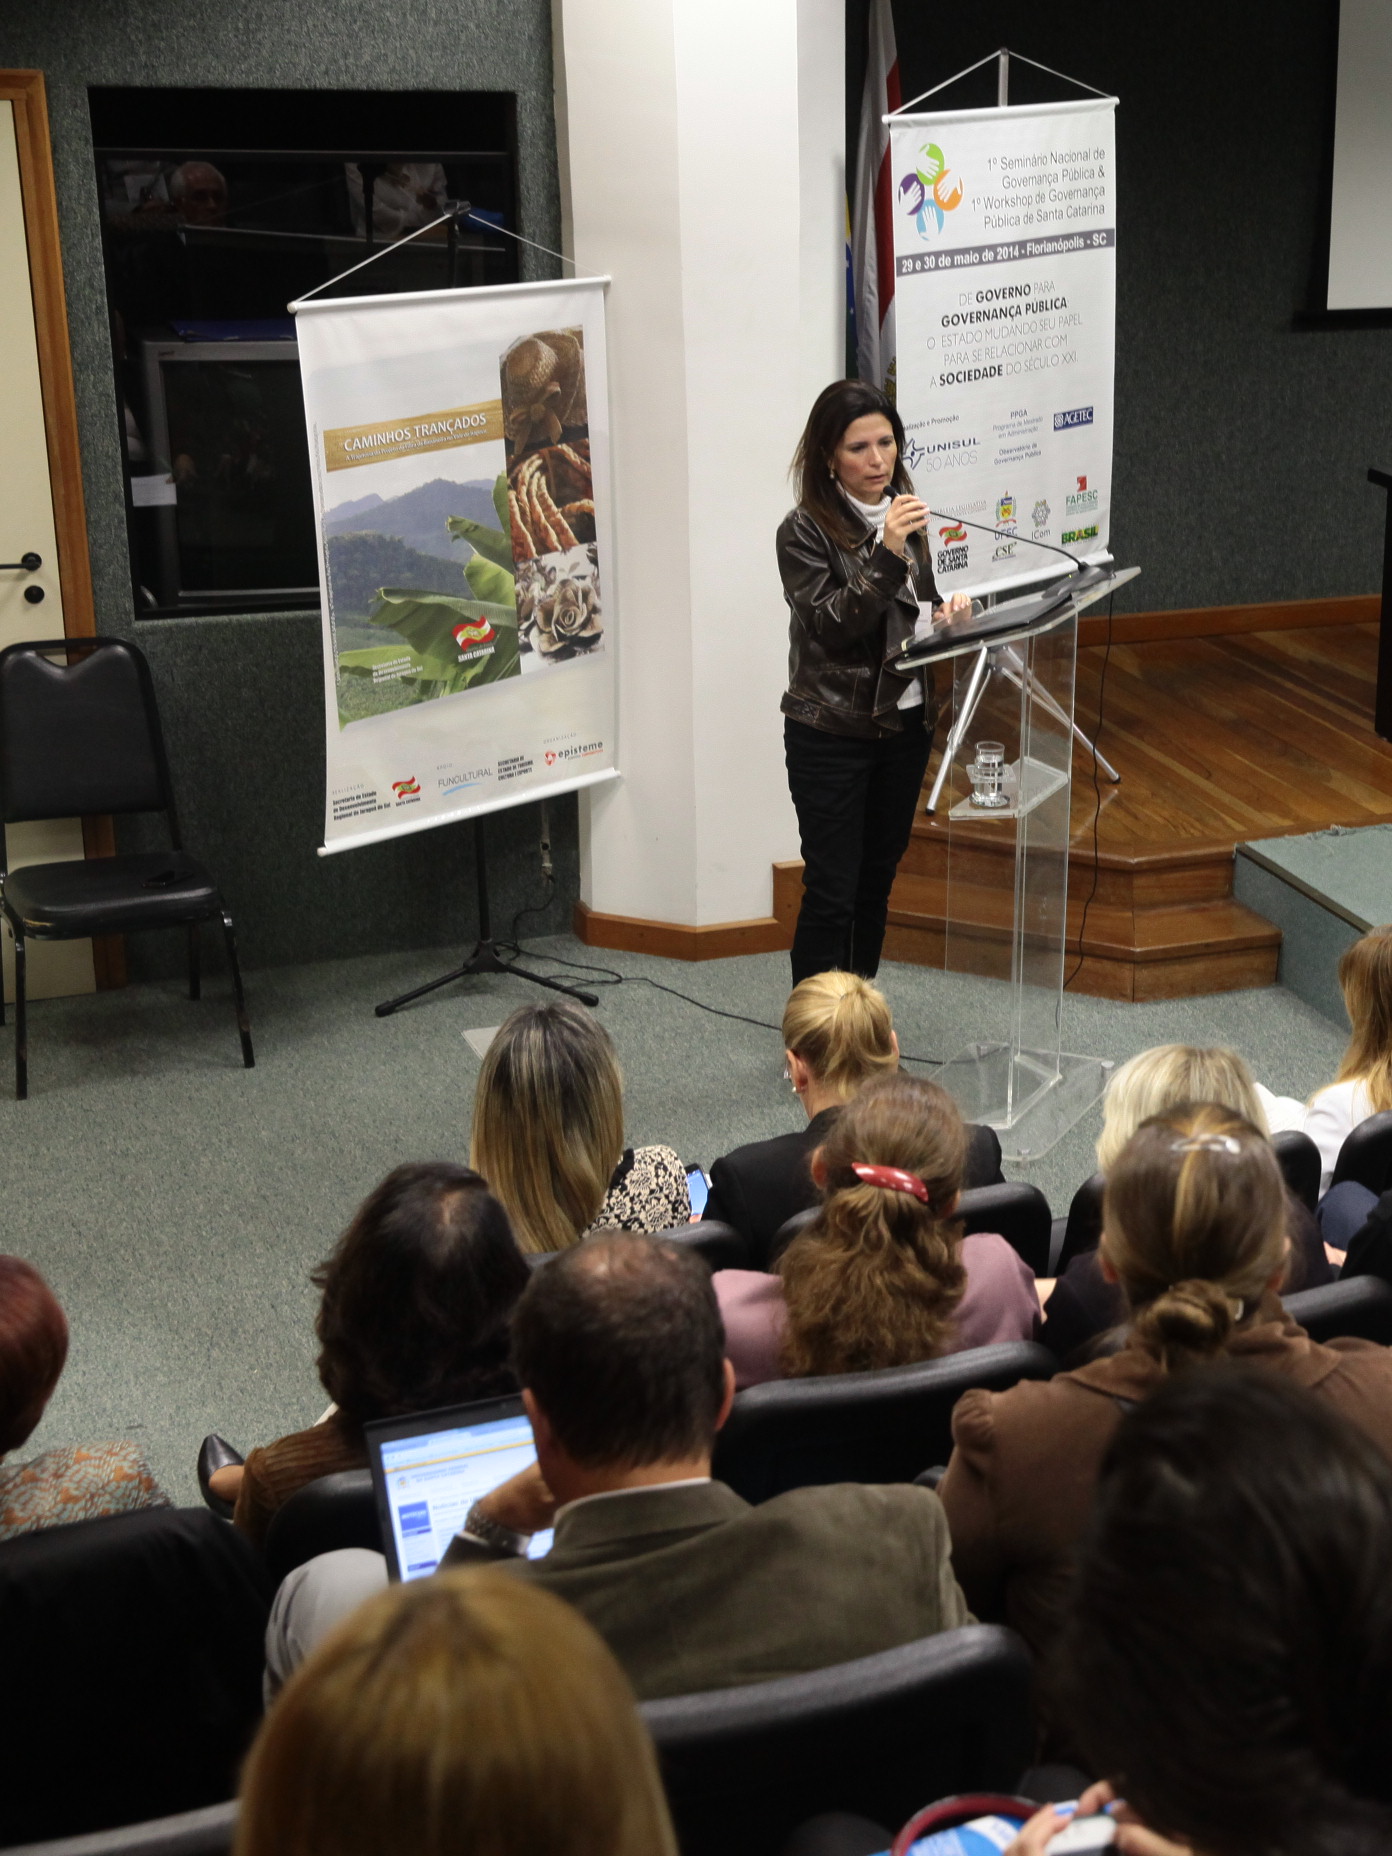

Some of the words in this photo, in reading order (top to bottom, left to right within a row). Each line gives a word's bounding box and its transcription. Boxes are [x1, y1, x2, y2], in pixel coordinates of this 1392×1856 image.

[1000, 153, 1048, 170] Seminário
[1050, 148, 1091, 165] Nacional
[1093, 147, 1105, 160] de
[1002, 173, 1058, 189] Governança
[1062, 167, 1095, 182] Pública
[1098, 165, 1105, 178] &
[984, 193, 1033, 210] Workshop
[1035, 191, 1046, 204] de
[1048, 185, 1105, 202] Governança
[984, 214, 1020, 230] Pública
[1023, 211, 1034, 225] de
[1036, 207, 1063, 223] Santa
[1066, 203, 1105, 219] Catarina
[901, 259, 913, 273] 29
[915, 260, 921, 270] e
[924, 256, 935, 269] 30
[938, 253, 951, 267] de
[954, 251, 980, 266] maio
[982, 248, 994, 262] de
[997, 245, 1019, 260] 2014
[1027, 236, 1084, 256] Florianópolis
[1093, 234, 1107, 246] SC
[959, 293, 972, 307] DE
[975, 284, 1031, 304] GOVERNO
[1033, 281, 1056, 295] PARA
[941, 304, 1022, 328] GOVERNANÇA
[1025, 297, 1067, 315] PÚBLICA
[927, 336, 936, 350] O
[941, 330, 983, 348] ESTADO
[985, 323, 1037, 342] MUDANDO
[1039, 319, 1055, 332] SEU
[1058, 313, 1082, 328] PAPEL
[944, 353, 969, 366] PARA
[972, 350, 982, 363] SE
[985, 340, 1043, 360] RELACIONAR
[1045, 334, 1068, 349] COM
[930, 376, 937, 389] A
[939, 364, 1003, 386] SOCIEDADE
[1006, 361, 1021, 375] DO
[1024, 353, 1059, 372] SÉCULO
[931, 414, 960, 426] Promoção
[1010, 409, 1028, 419] PPGA
[1064, 408, 1093, 425] AGETEC
[344, 428, 411, 452] CAMINHOS
[413, 412, 487, 438] TRANÇADOS
[926, 437, 981, 454] UNISUL
[926, 456, 942, 473] 50
[944, 450, 978, 470] ANOS
[1066, 490, 1098, 506] FAPESC
[1062, 525, 1099, 545] BRASIL
[937, 545, 968, 558] GOVERNO
[937, 558, 946, 566] DE
[947, 553, 968, 565] SANTA
[937, 561, 968, 574] CATARINA
[558, 740, 603, 760] episteme
[438, 768, 493, 788] FUNCULTURAL
